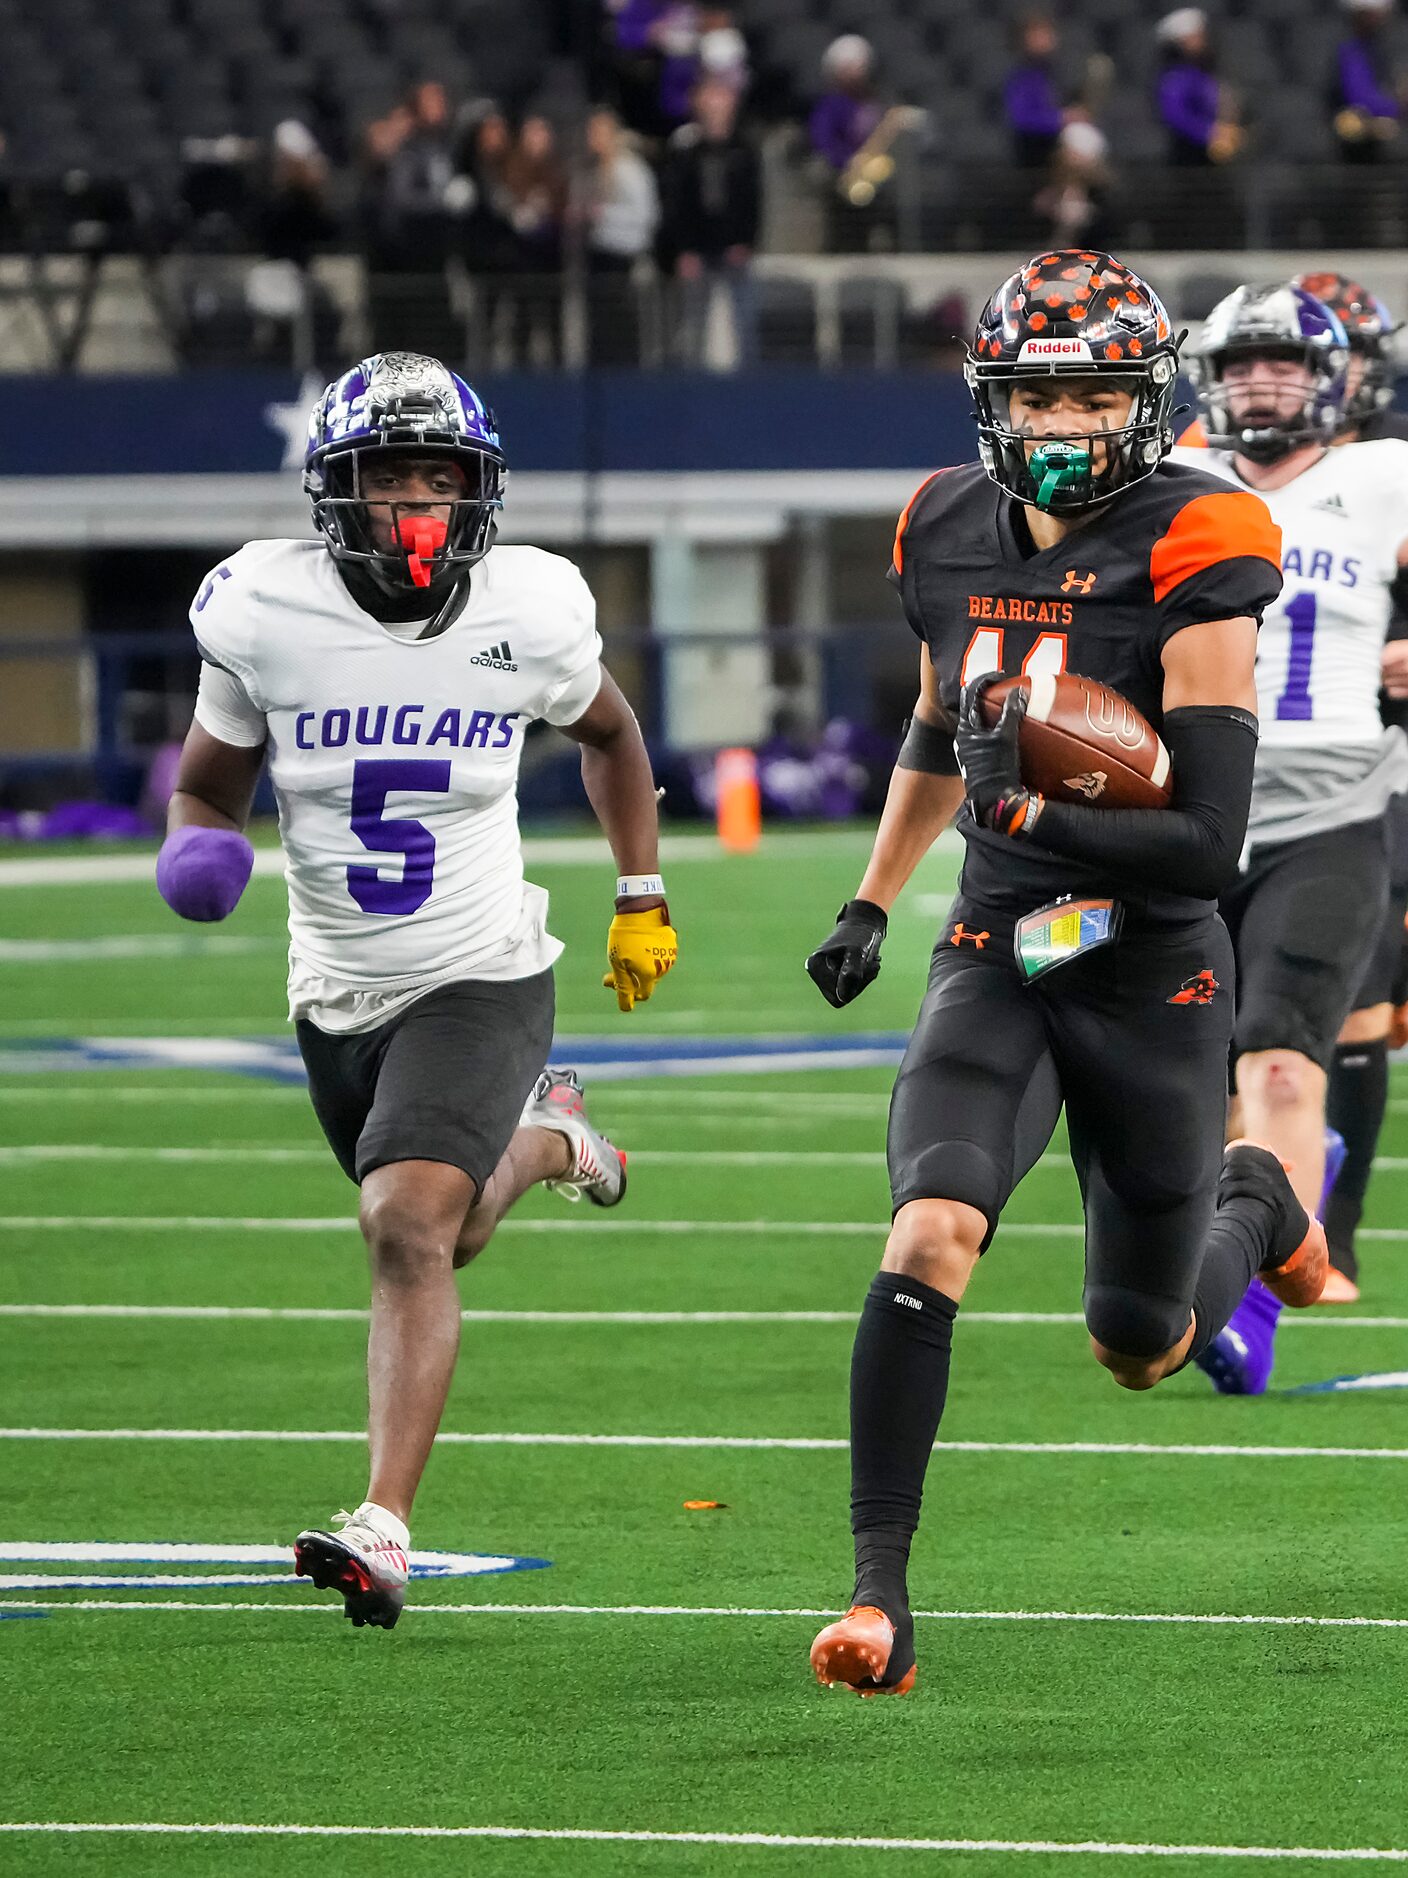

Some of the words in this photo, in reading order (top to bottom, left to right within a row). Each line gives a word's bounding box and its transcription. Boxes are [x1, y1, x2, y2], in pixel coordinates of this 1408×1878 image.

[1027, 341, 1081, 354] Riddell
[1281, 546, 1362, 588] ARS
[195, 566, 232, 612] 5
[968, 595, 1073, 626] BEARCATS
[470, 656, 519, 672] adidas
[1275, 591, 1317, 721] 1
[296, 705, 519, 749] COUGARS
[346, 758, 453, 916] 5
[893, 1292, 923, 1311] NXTRND
